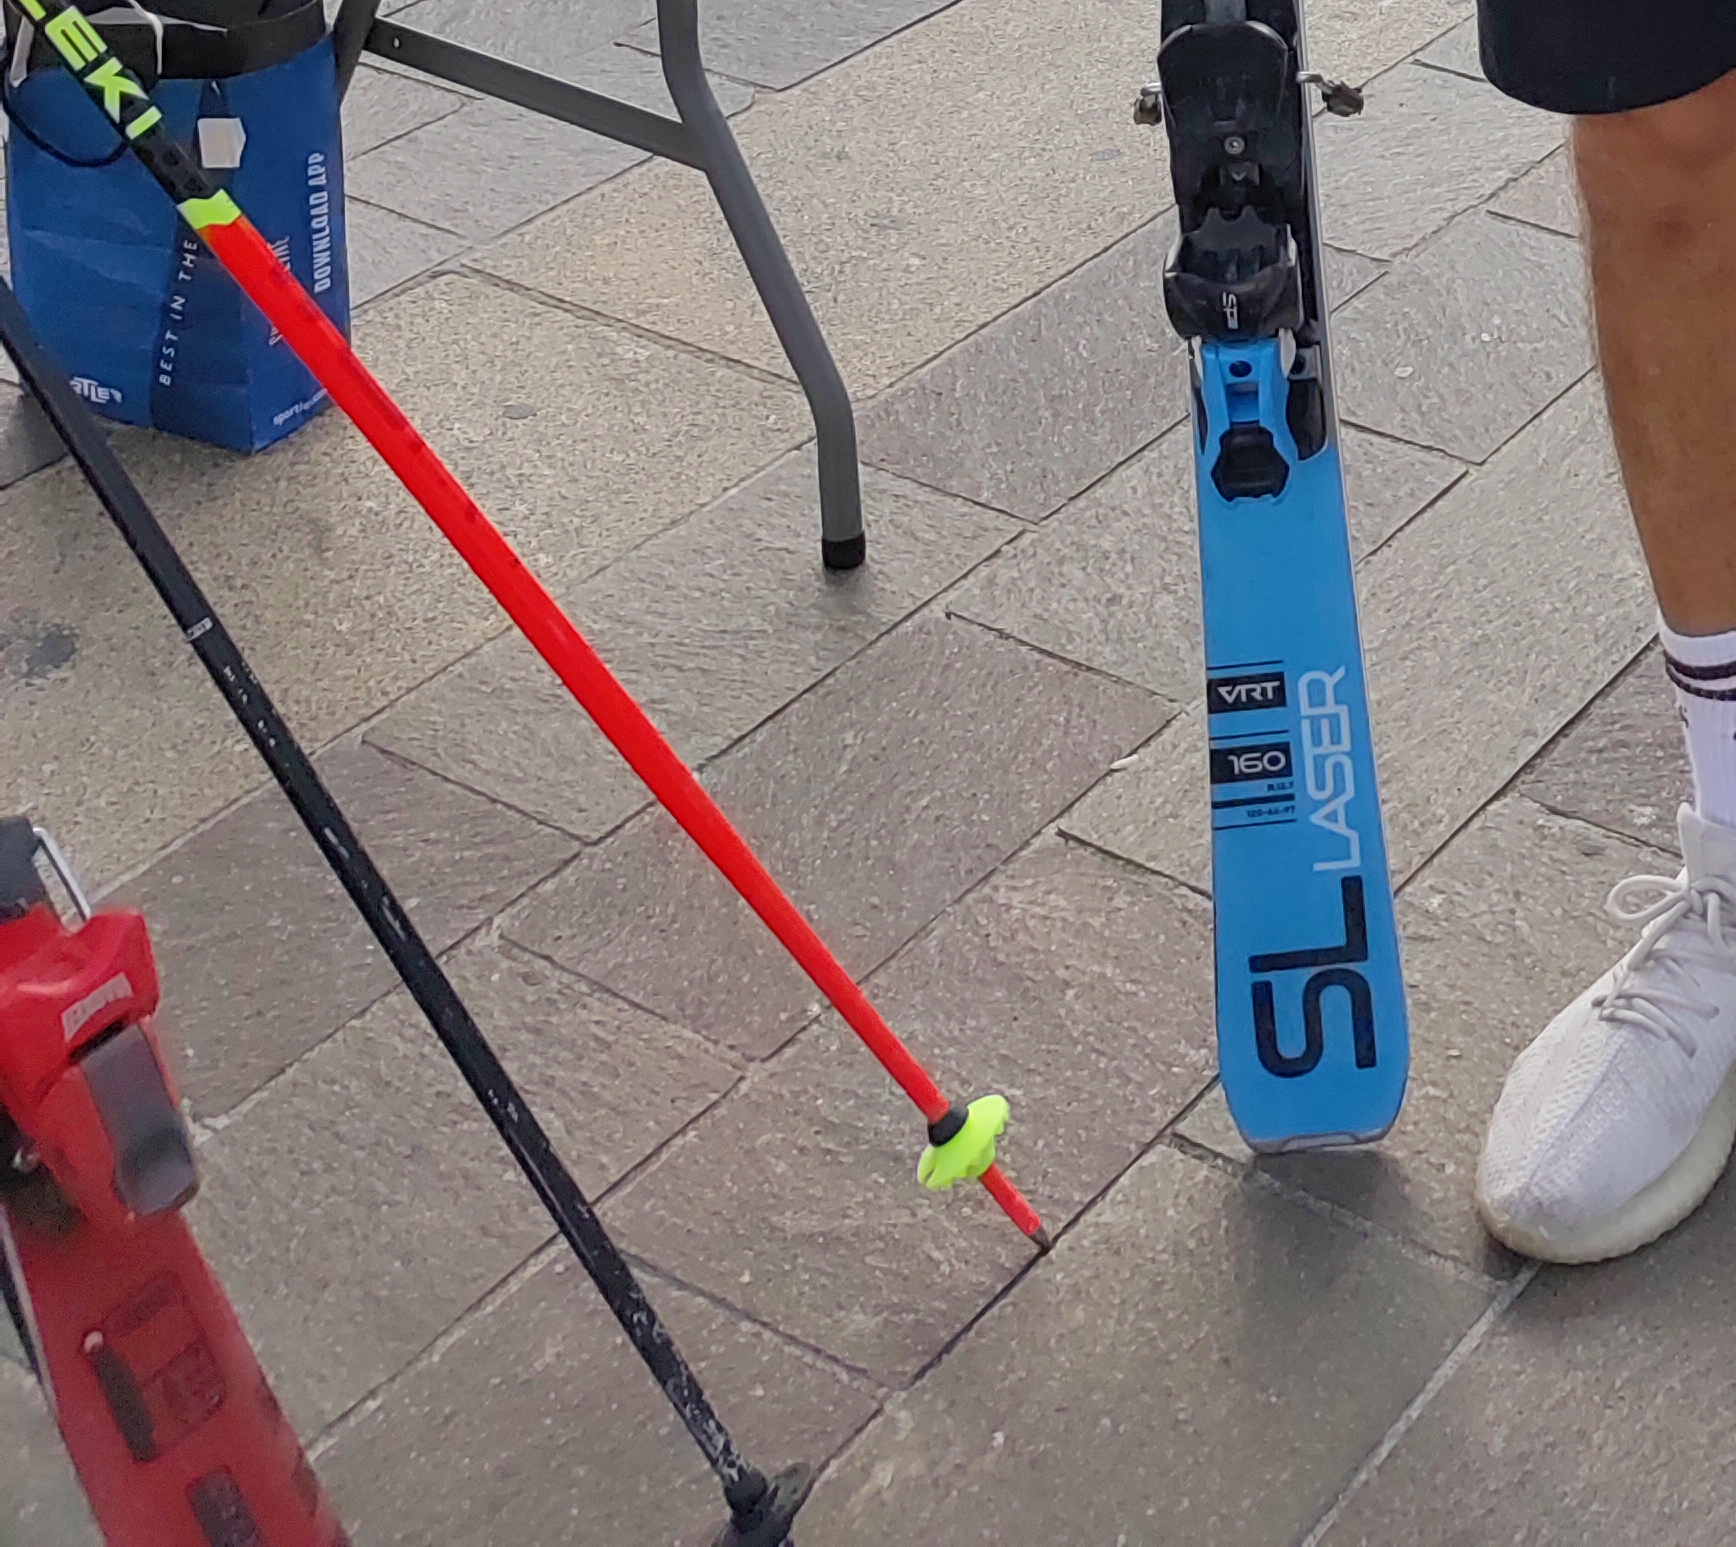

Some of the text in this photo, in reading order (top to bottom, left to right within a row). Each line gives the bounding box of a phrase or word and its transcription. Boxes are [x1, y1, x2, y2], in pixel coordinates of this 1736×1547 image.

[307, 152, 332, 294] DOWNLOAD APP
[158, 238, 199, 387] BEST IN THE
[1217, 681, 1280, 704] VRT
[1227, 750, 1286, 775] 160
[1249, 664, 1377, 1078] SL LASER
